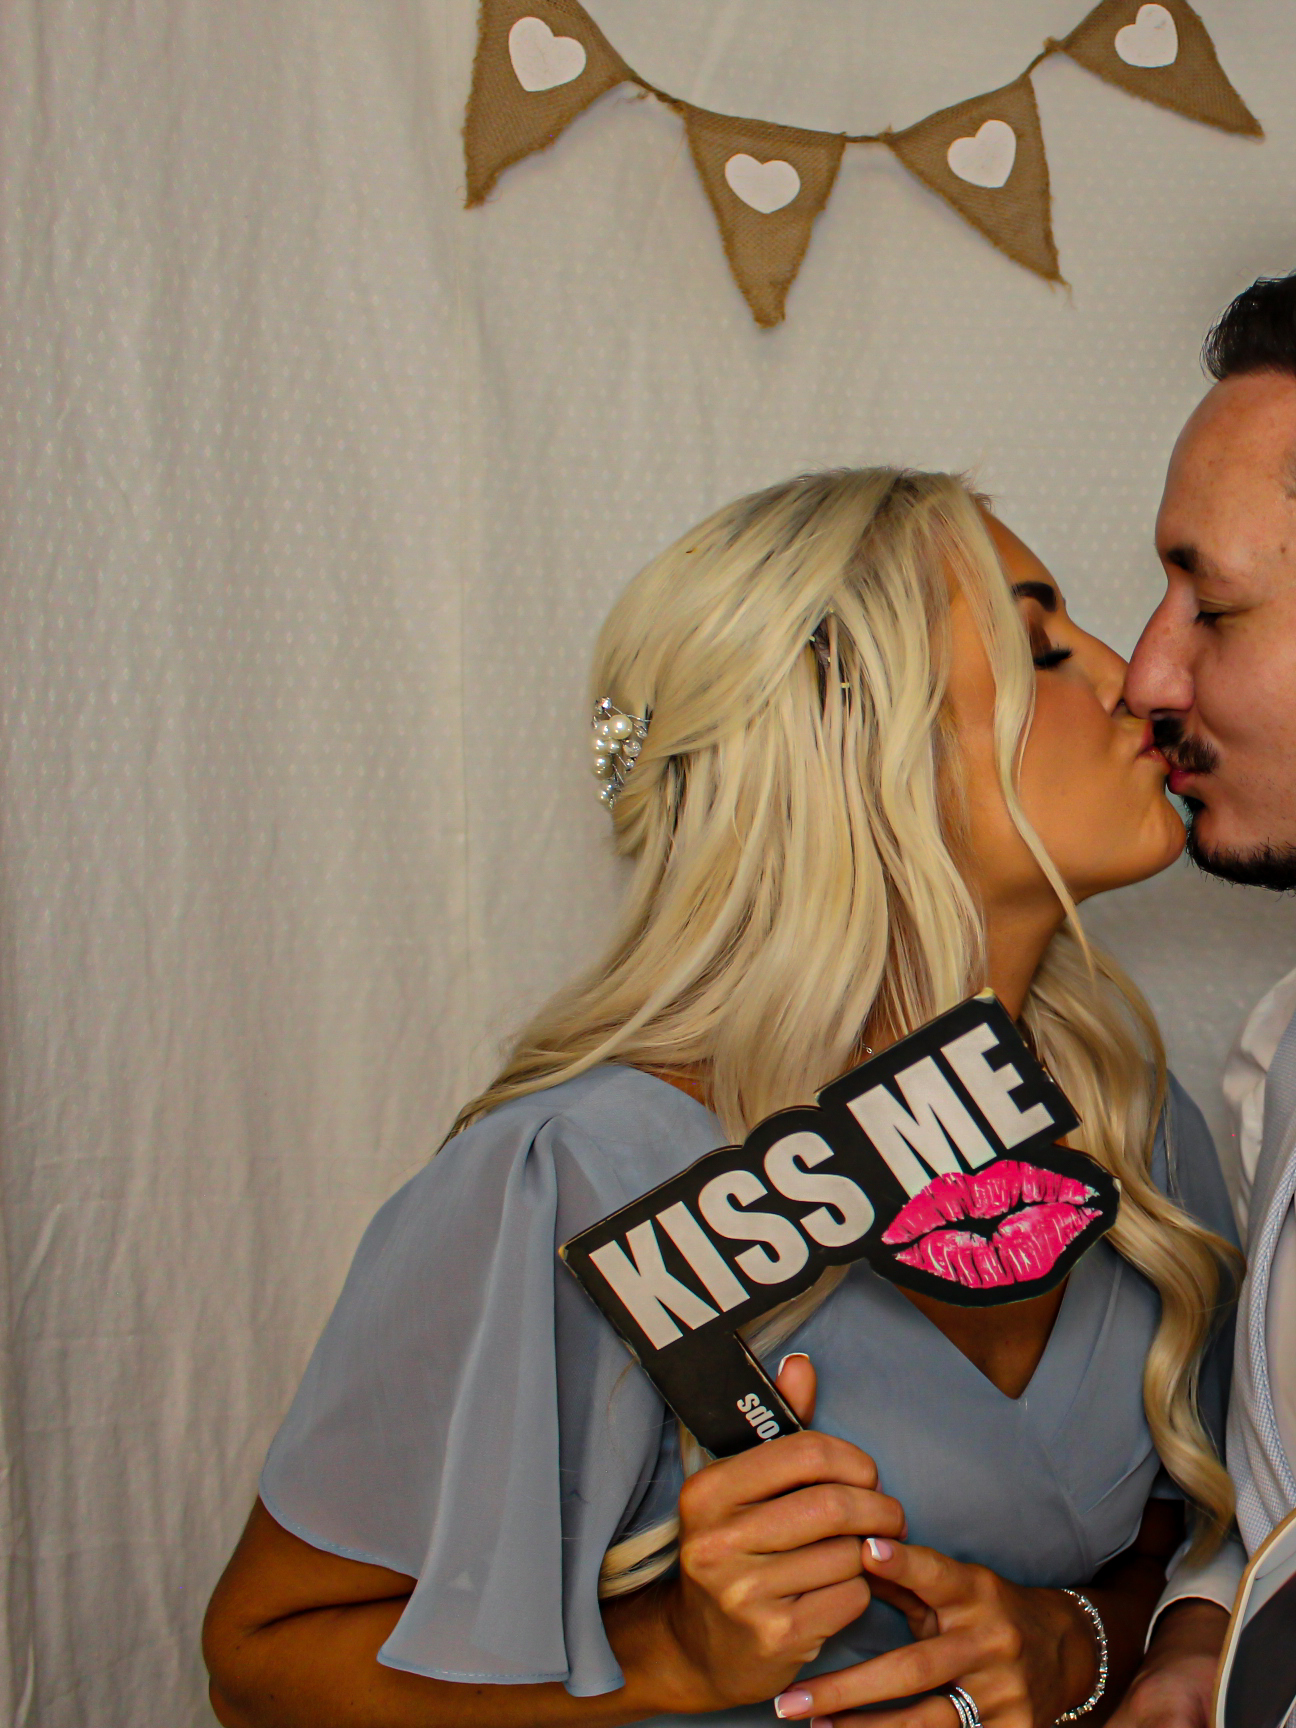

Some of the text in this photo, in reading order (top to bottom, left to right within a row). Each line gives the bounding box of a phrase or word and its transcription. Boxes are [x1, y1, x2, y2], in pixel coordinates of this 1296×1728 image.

[588, 1022, 1055, 1351] KISS ME
[736, 1393, 786, 1443] ops
